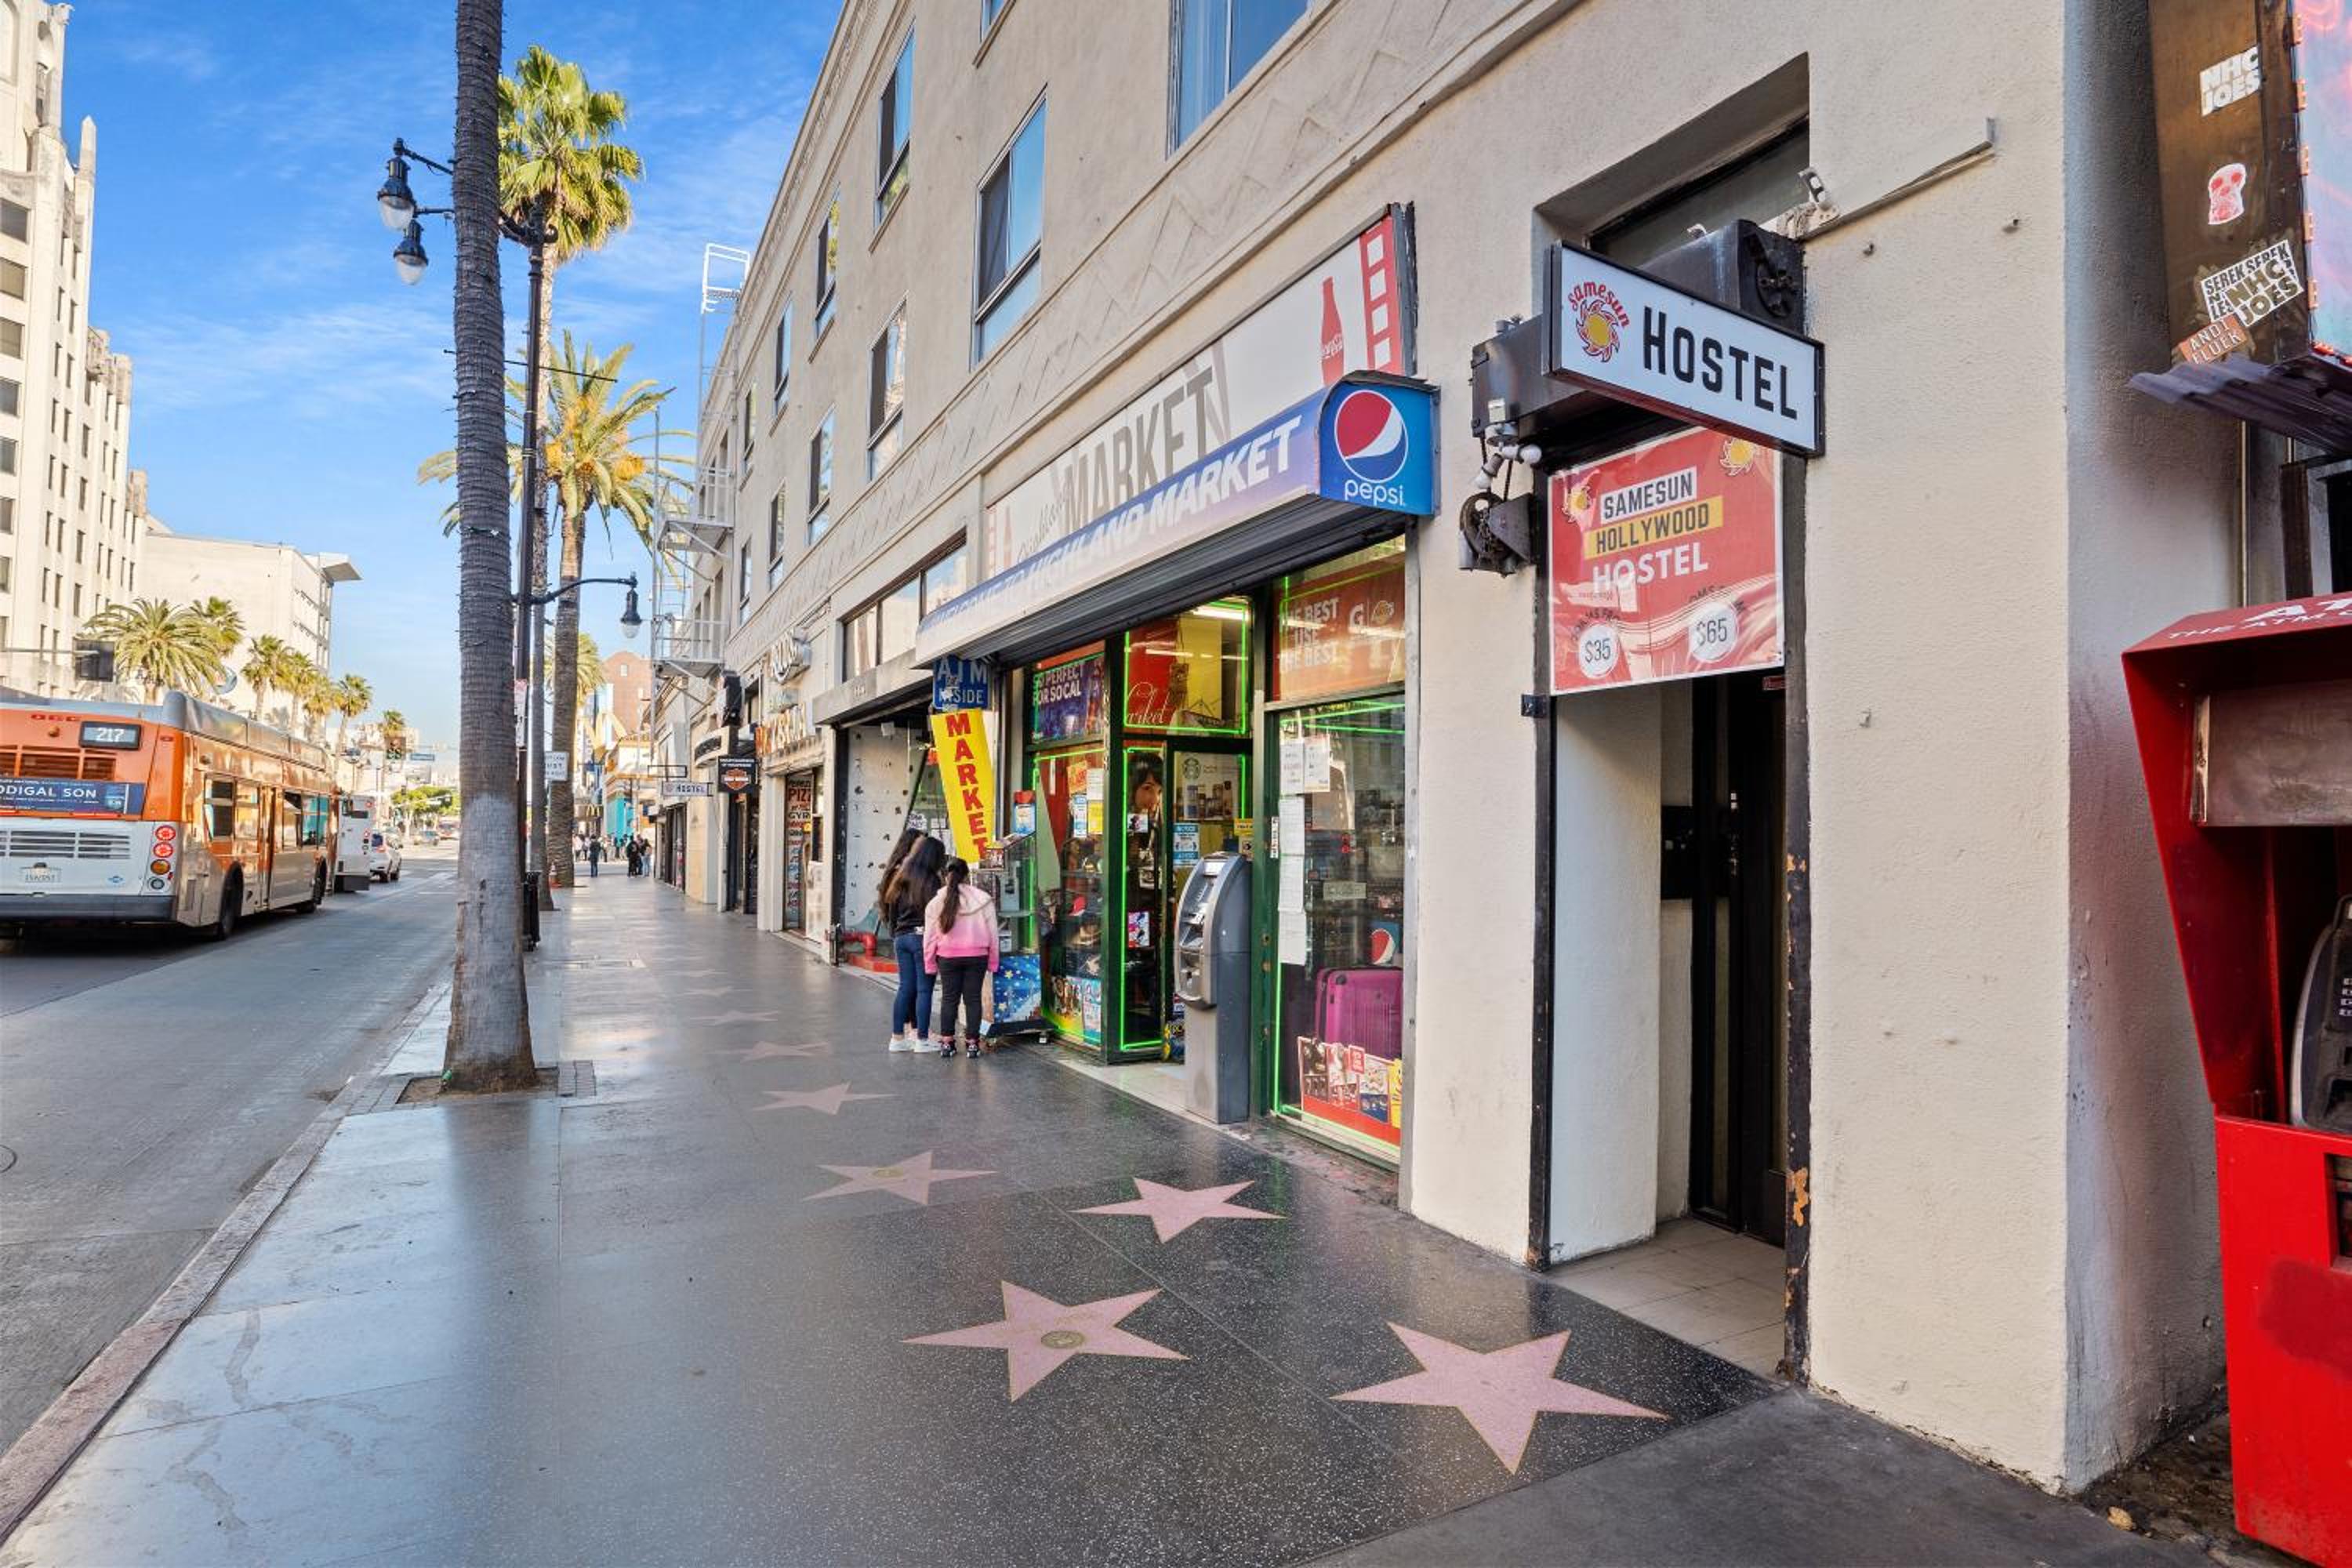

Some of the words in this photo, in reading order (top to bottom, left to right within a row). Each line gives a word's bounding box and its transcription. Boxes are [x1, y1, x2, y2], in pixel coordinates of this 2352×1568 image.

[2205, 263, 2246, 295] SEREK
[1567, 280, 1630, 330] samesun
[1643, 307, 1798, 420] HOSTEL
[1062, 365, 1214, 536] MARKET
[1149, 415, 1302, 535] MARKET
[1344, 478, 1406, 507] pepsi
[1603, 470, 1693, 520] SAMESUN
[1596, 502, 1710, 555] HOLLYWOOD
[1592, 543, 1708, 593] HOSTEL
[1305, 597, 1340, 626] BEST
[1696, 618, 1728, 647] $65
[1584, 638, 1611, 663] $35
[1050, 680, 1081, 702] SOCAL
[96, 727, 125, 742] 217
[63, 787, 97, 799] SON
[677, 784, 706, 793] HOSTEL
[946, 712, 991, 860] MARKET
